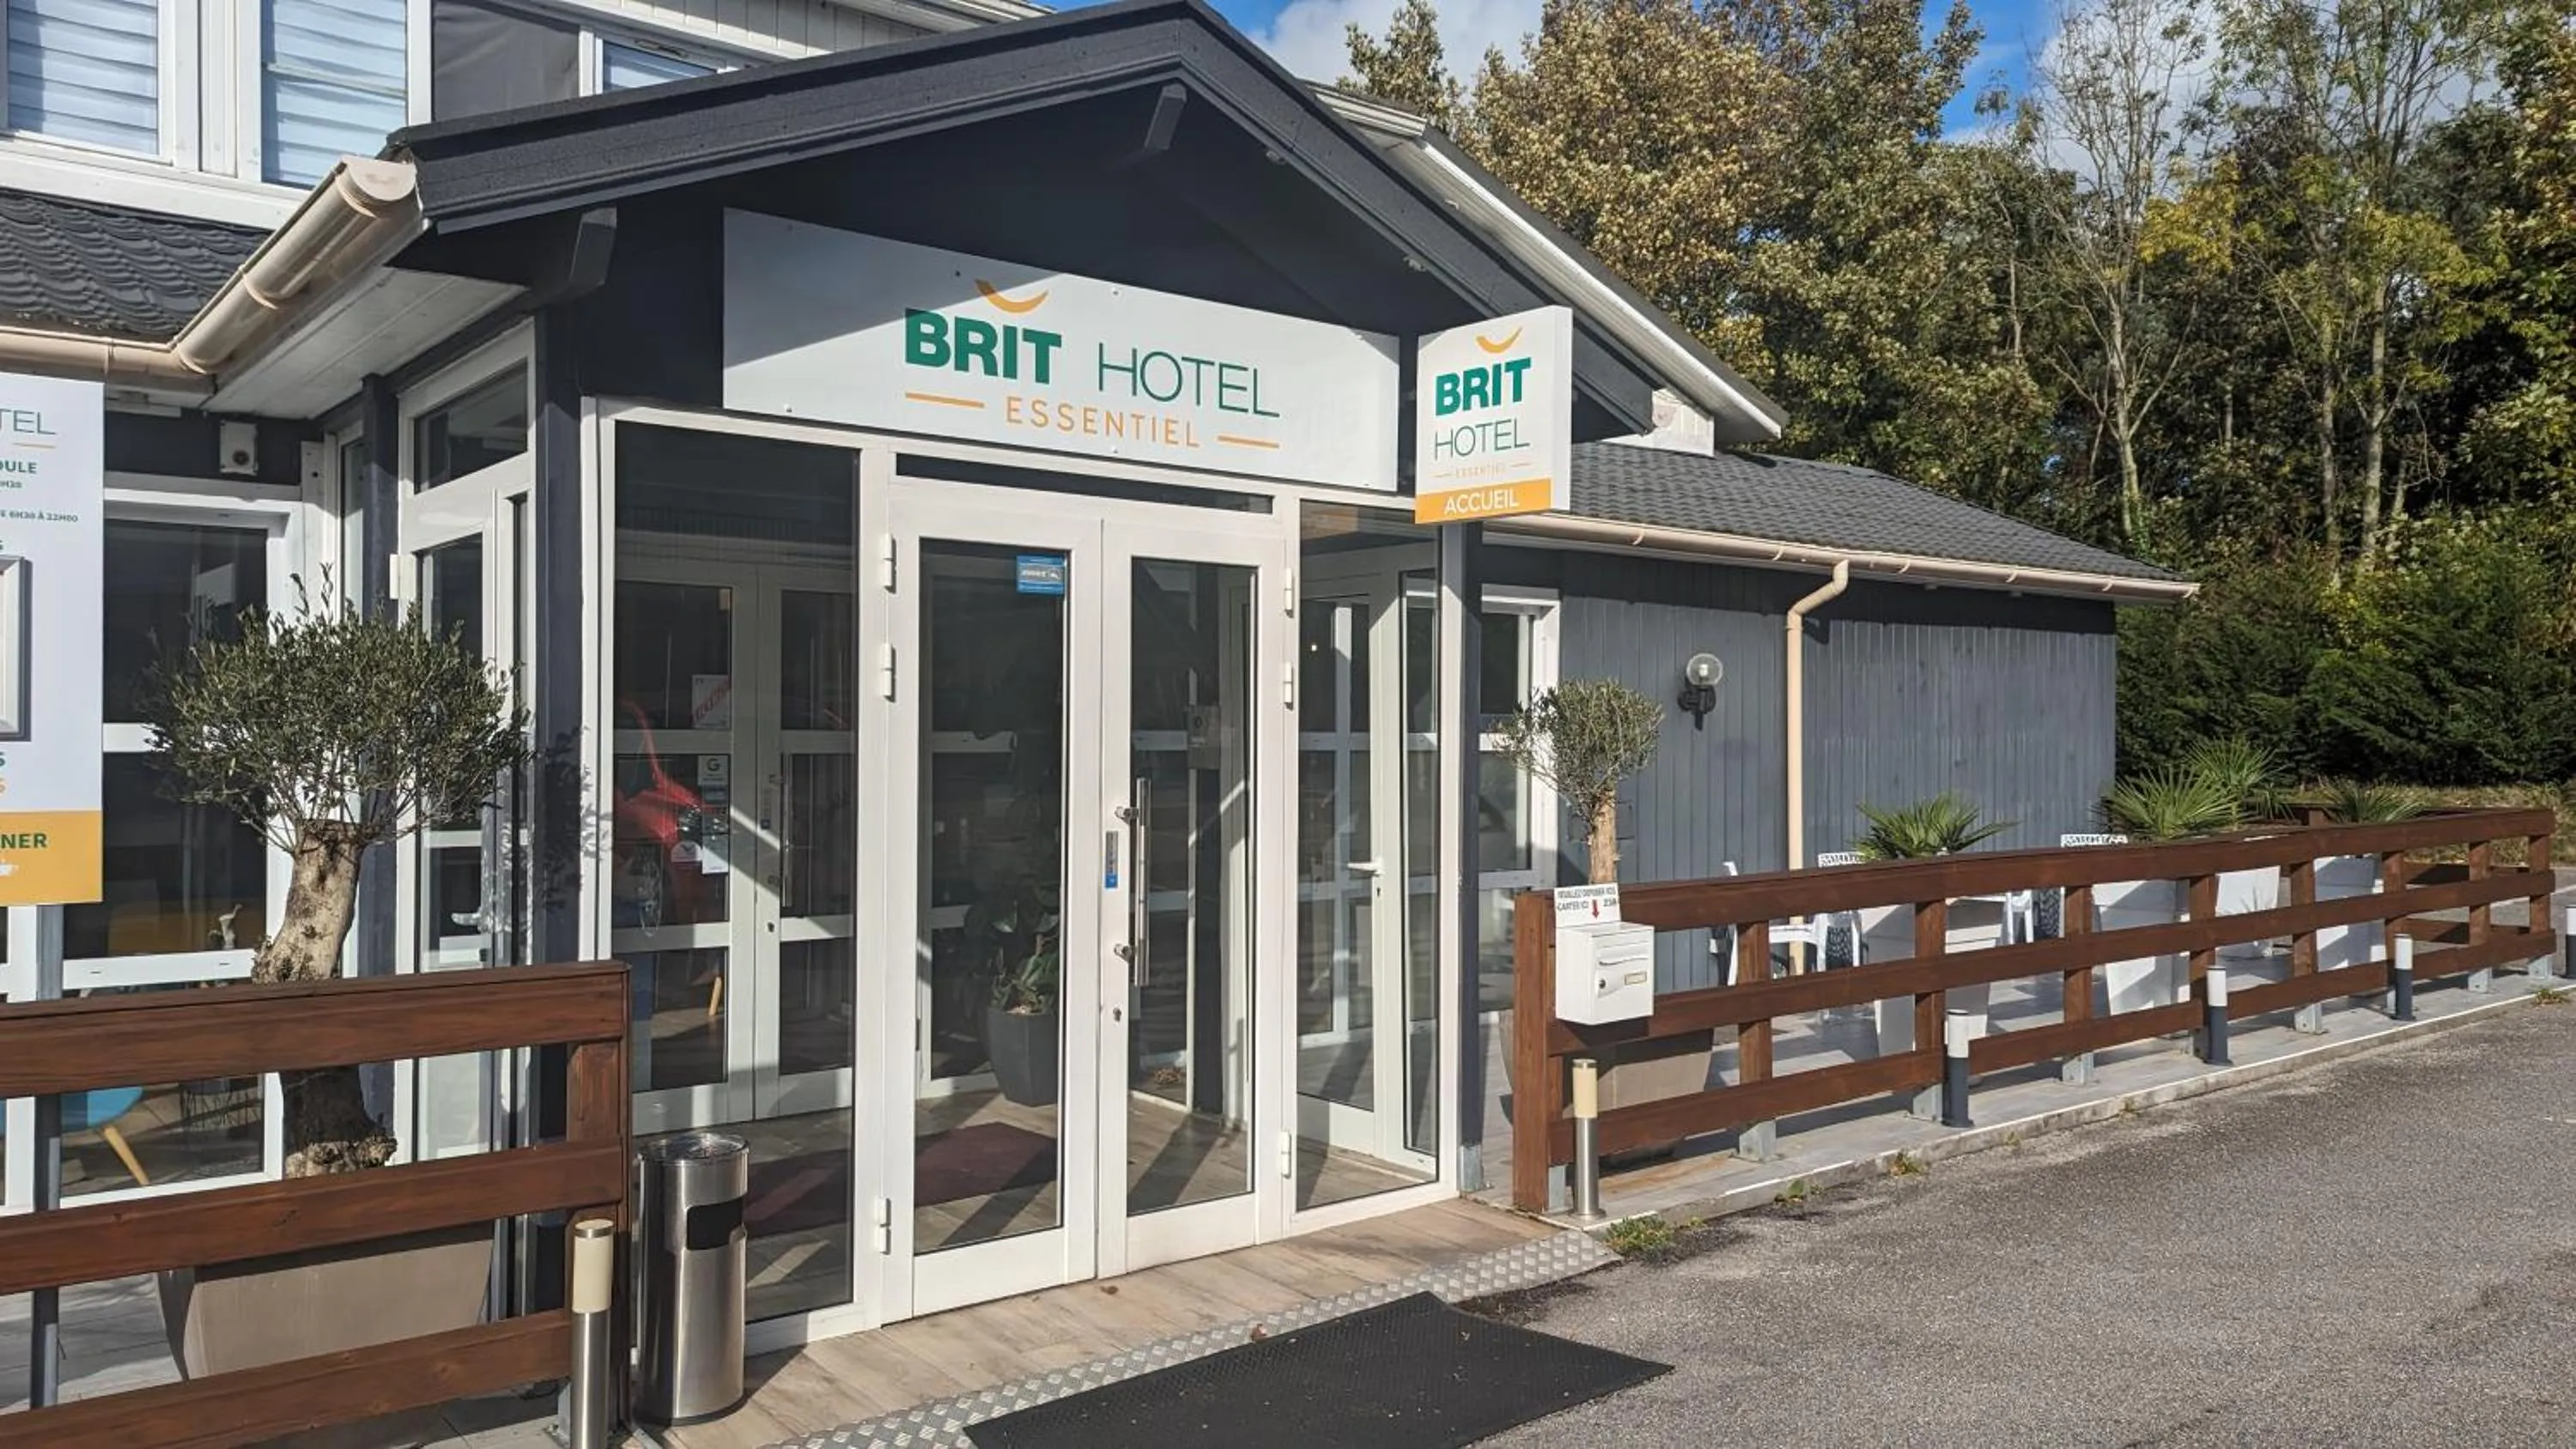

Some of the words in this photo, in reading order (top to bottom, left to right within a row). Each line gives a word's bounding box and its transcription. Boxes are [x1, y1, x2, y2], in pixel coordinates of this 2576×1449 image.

[905, 308, 1061, 385] BRIT
[1099, 343, 1279, 417] HOTEL
[1436, 357, 1532, 416] BRIT
[1006, 396, 1199, 448] ESSENTIEL
[1435, 417, 1530, 461] HOTEL
[1443, 488, 1520, 515] ACCUEIL
[1, 833, 47, 849] NER
